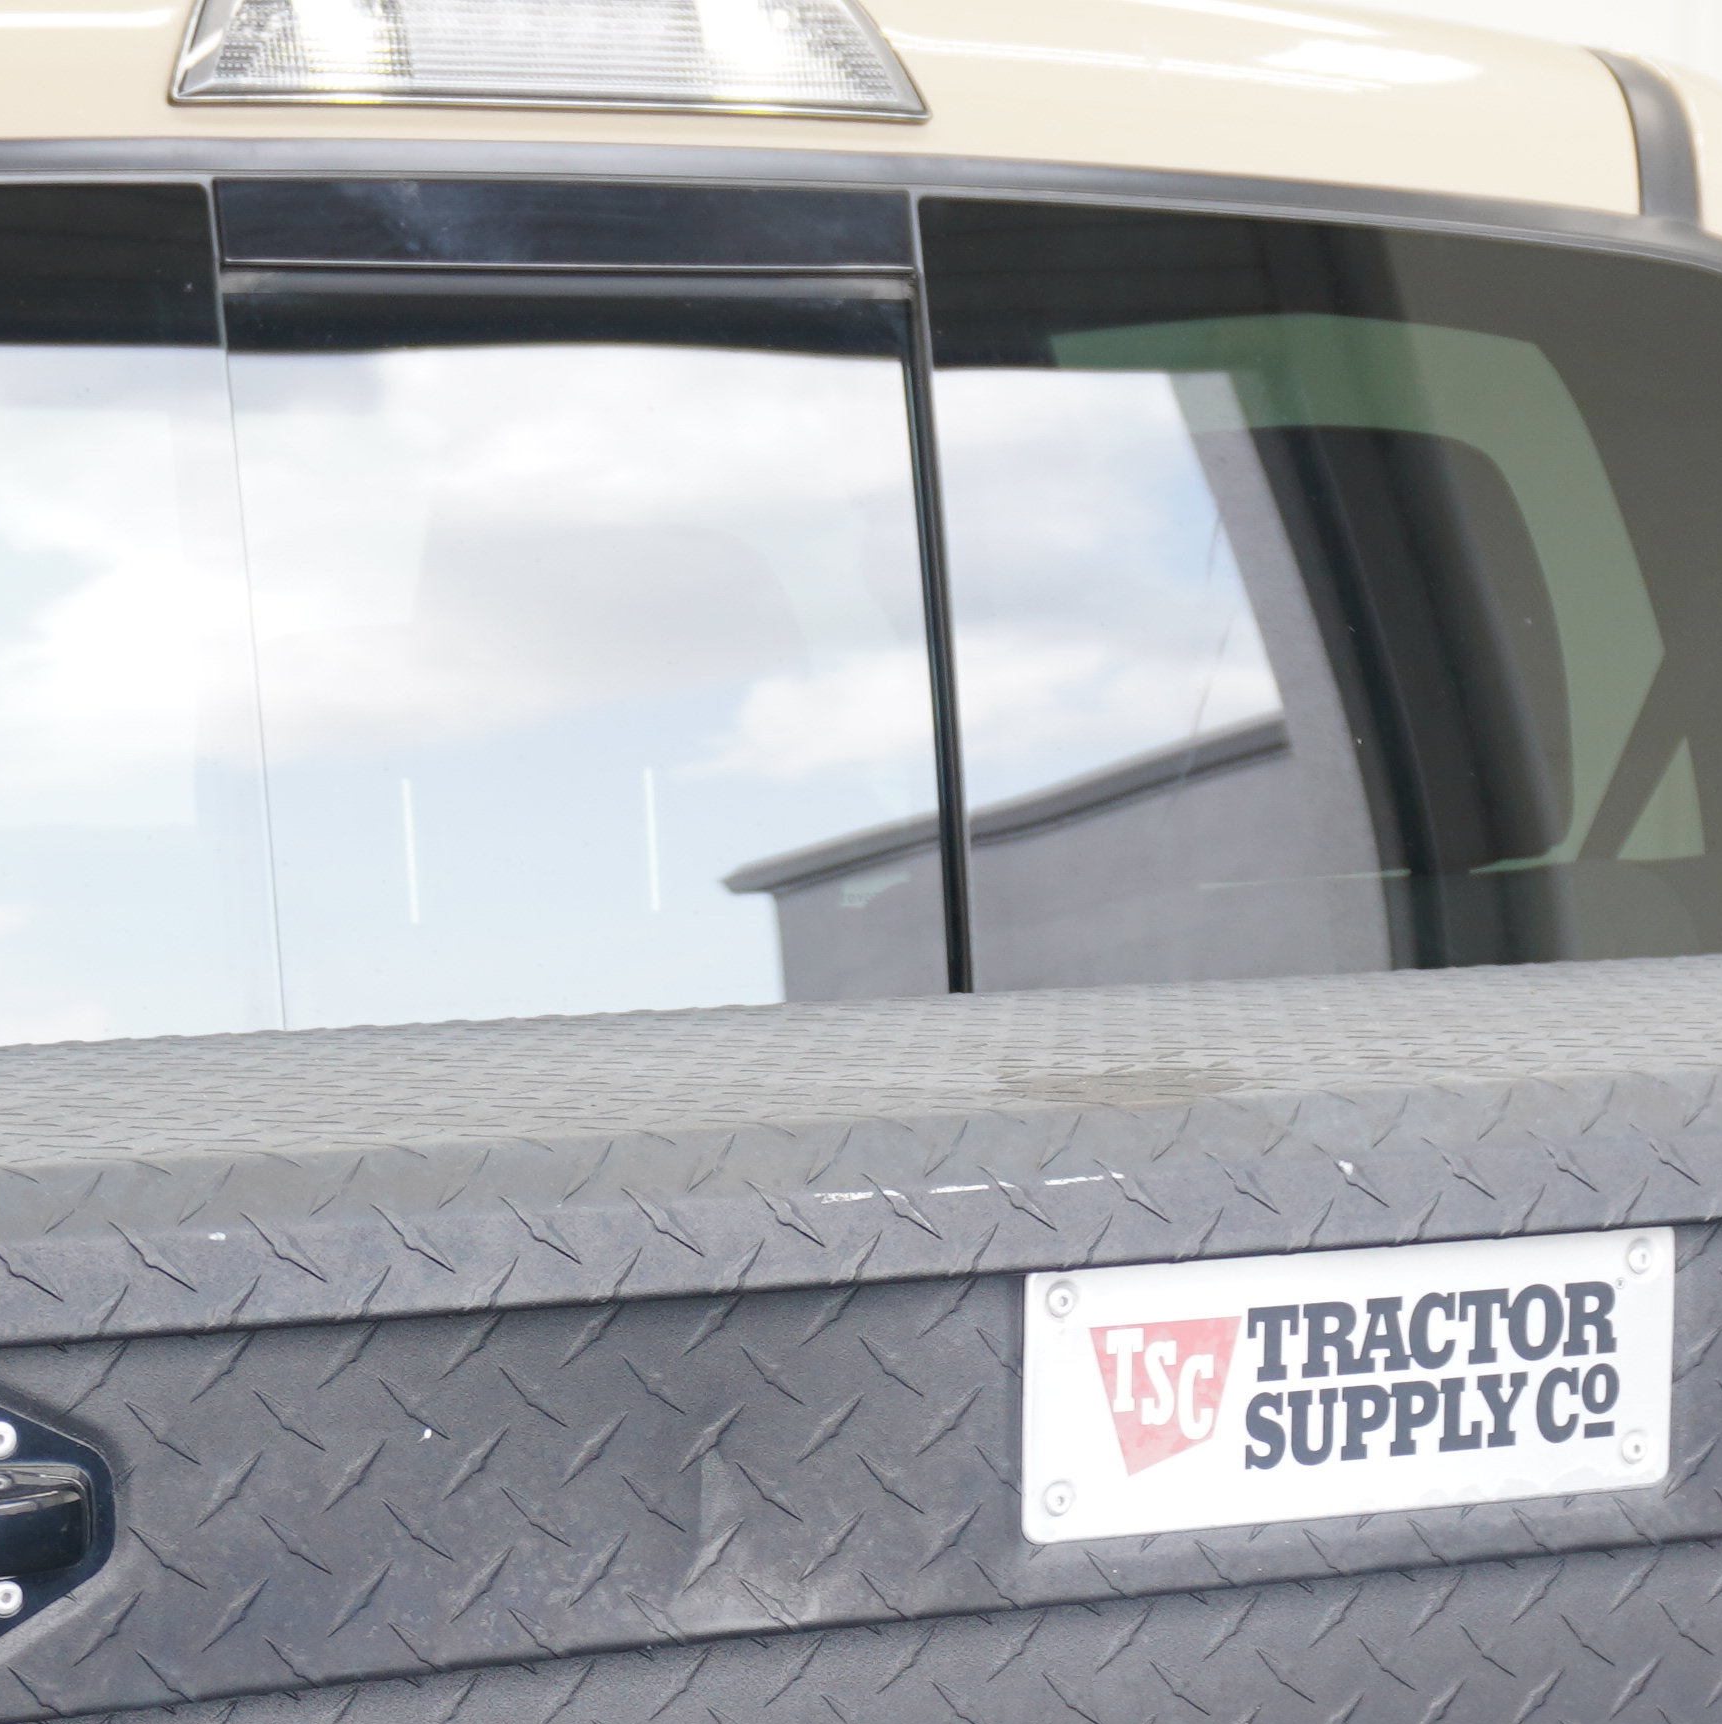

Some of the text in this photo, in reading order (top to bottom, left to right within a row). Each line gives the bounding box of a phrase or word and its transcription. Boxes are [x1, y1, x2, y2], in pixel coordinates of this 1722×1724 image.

[1247, 1281, 1617, 1381] TRACTOR
[1105, 1327, 1215, 1440] TSC
[1245, 1371, 1528, 1470] SUPPLY
